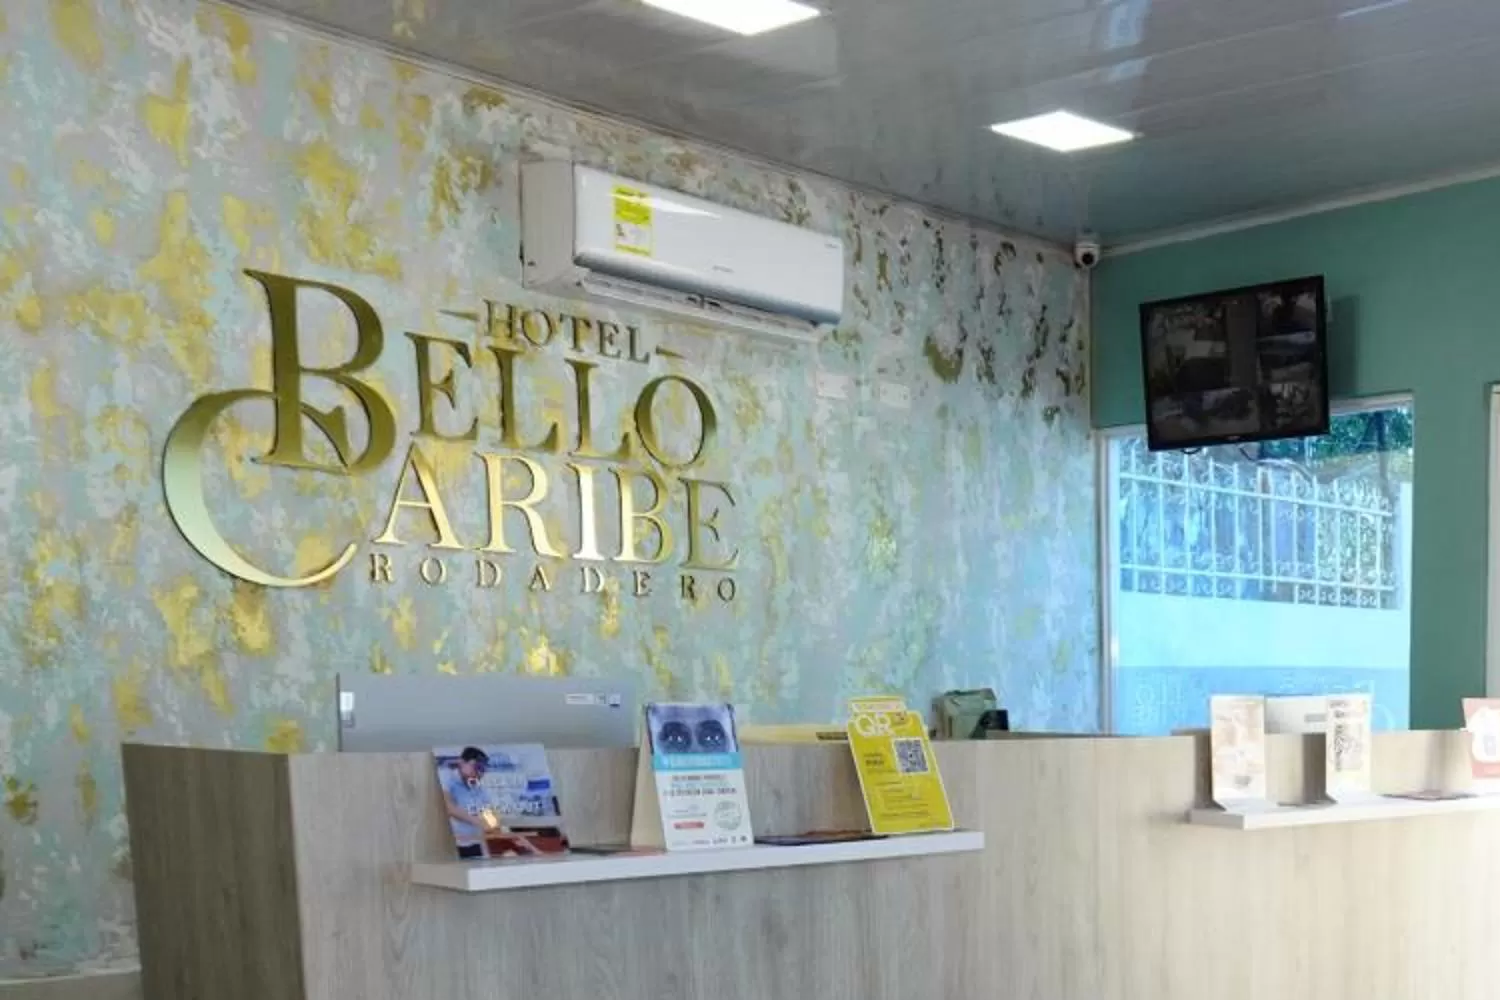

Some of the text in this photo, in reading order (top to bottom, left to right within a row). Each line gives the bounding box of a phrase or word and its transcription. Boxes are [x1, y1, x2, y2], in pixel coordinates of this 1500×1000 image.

[243, 267, 718, 476] BELLO
[482, 298, 651, 366] HOTEL
[161, 388, 740, 587] CARIBE
[369, 552, 737, 602] RODADERO
